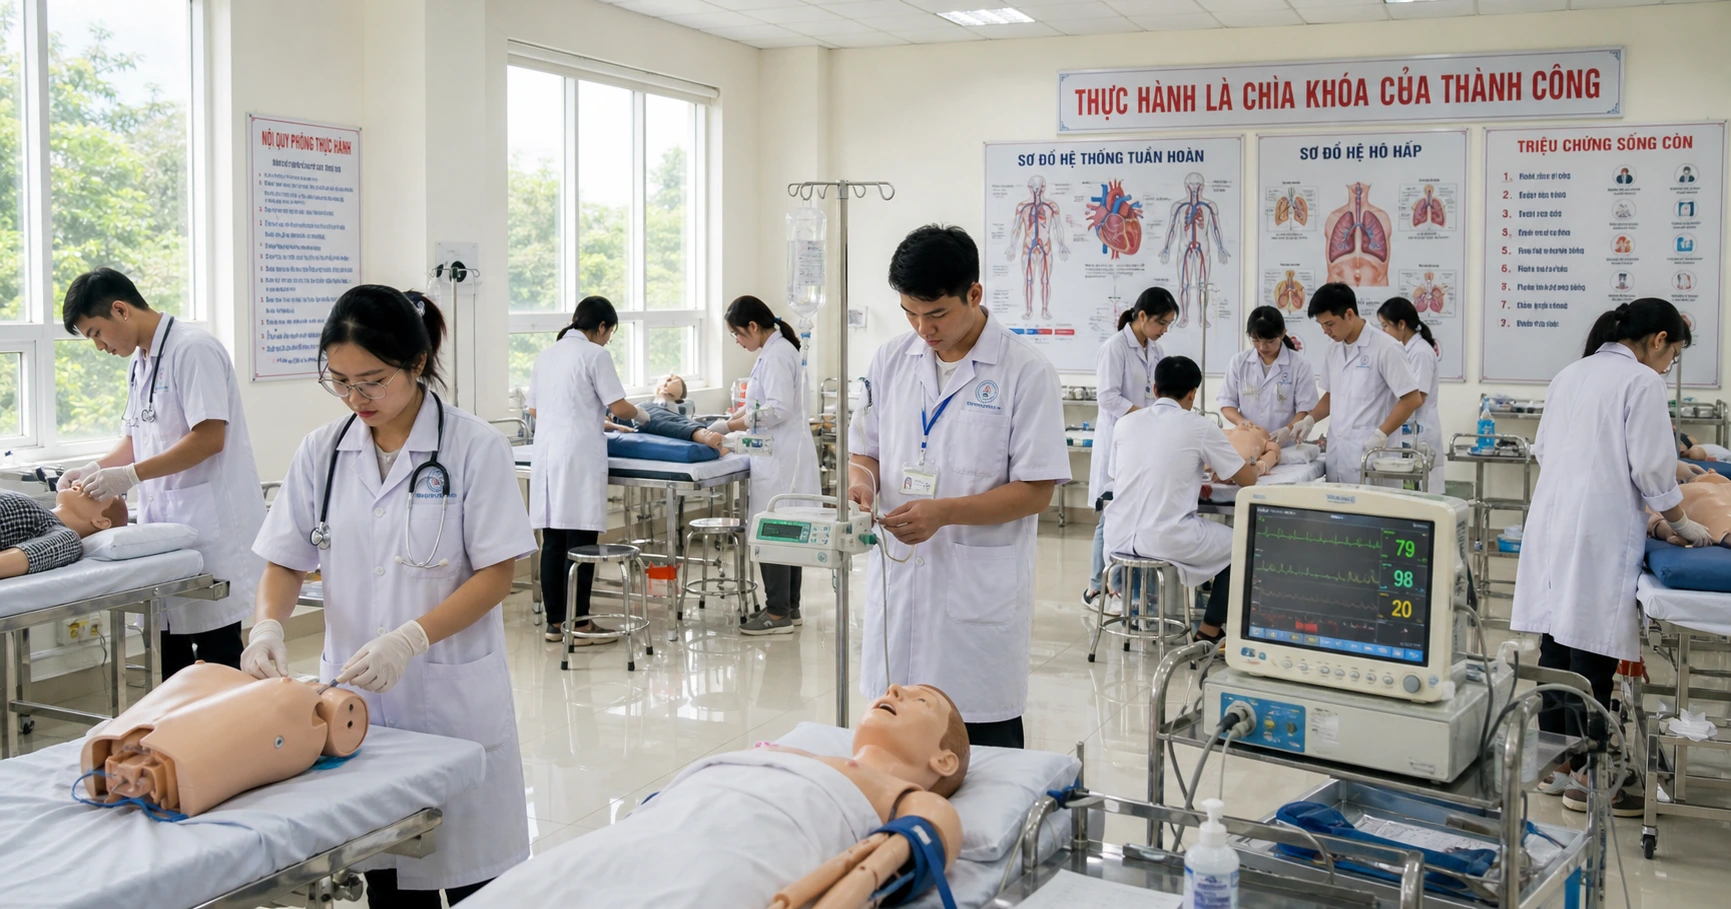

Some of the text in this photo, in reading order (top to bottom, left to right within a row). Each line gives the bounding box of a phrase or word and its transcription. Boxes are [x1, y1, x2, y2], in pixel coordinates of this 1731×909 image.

[1075, 64, 1600, 120] THỰC HÀNH LÀ CHÌA KHÓA CỦA THÀNH CÔNG
[276, 133, 289, 149] QUY
[1518, 133, 1693, 155] TRIỆU CHỨNG SỐNG CÒN
[1018, 153, 1035, 166] SƠ
[1060, 150, 1076, 168] HỆ
[1081, 148, 1123, 165] THỐNG
[1168, 147, 1204, 163] HOÀN
[1300, 146, 1318, 160] SƠ
[1347, 143, 1364, 162] HỆ
[1393, 141, 1422, 158] HẤP
[1396, 539, 1415, 558] 79
[1394, 570, 1413, 588] 98
[1391, 599, 1412, 618] 20
